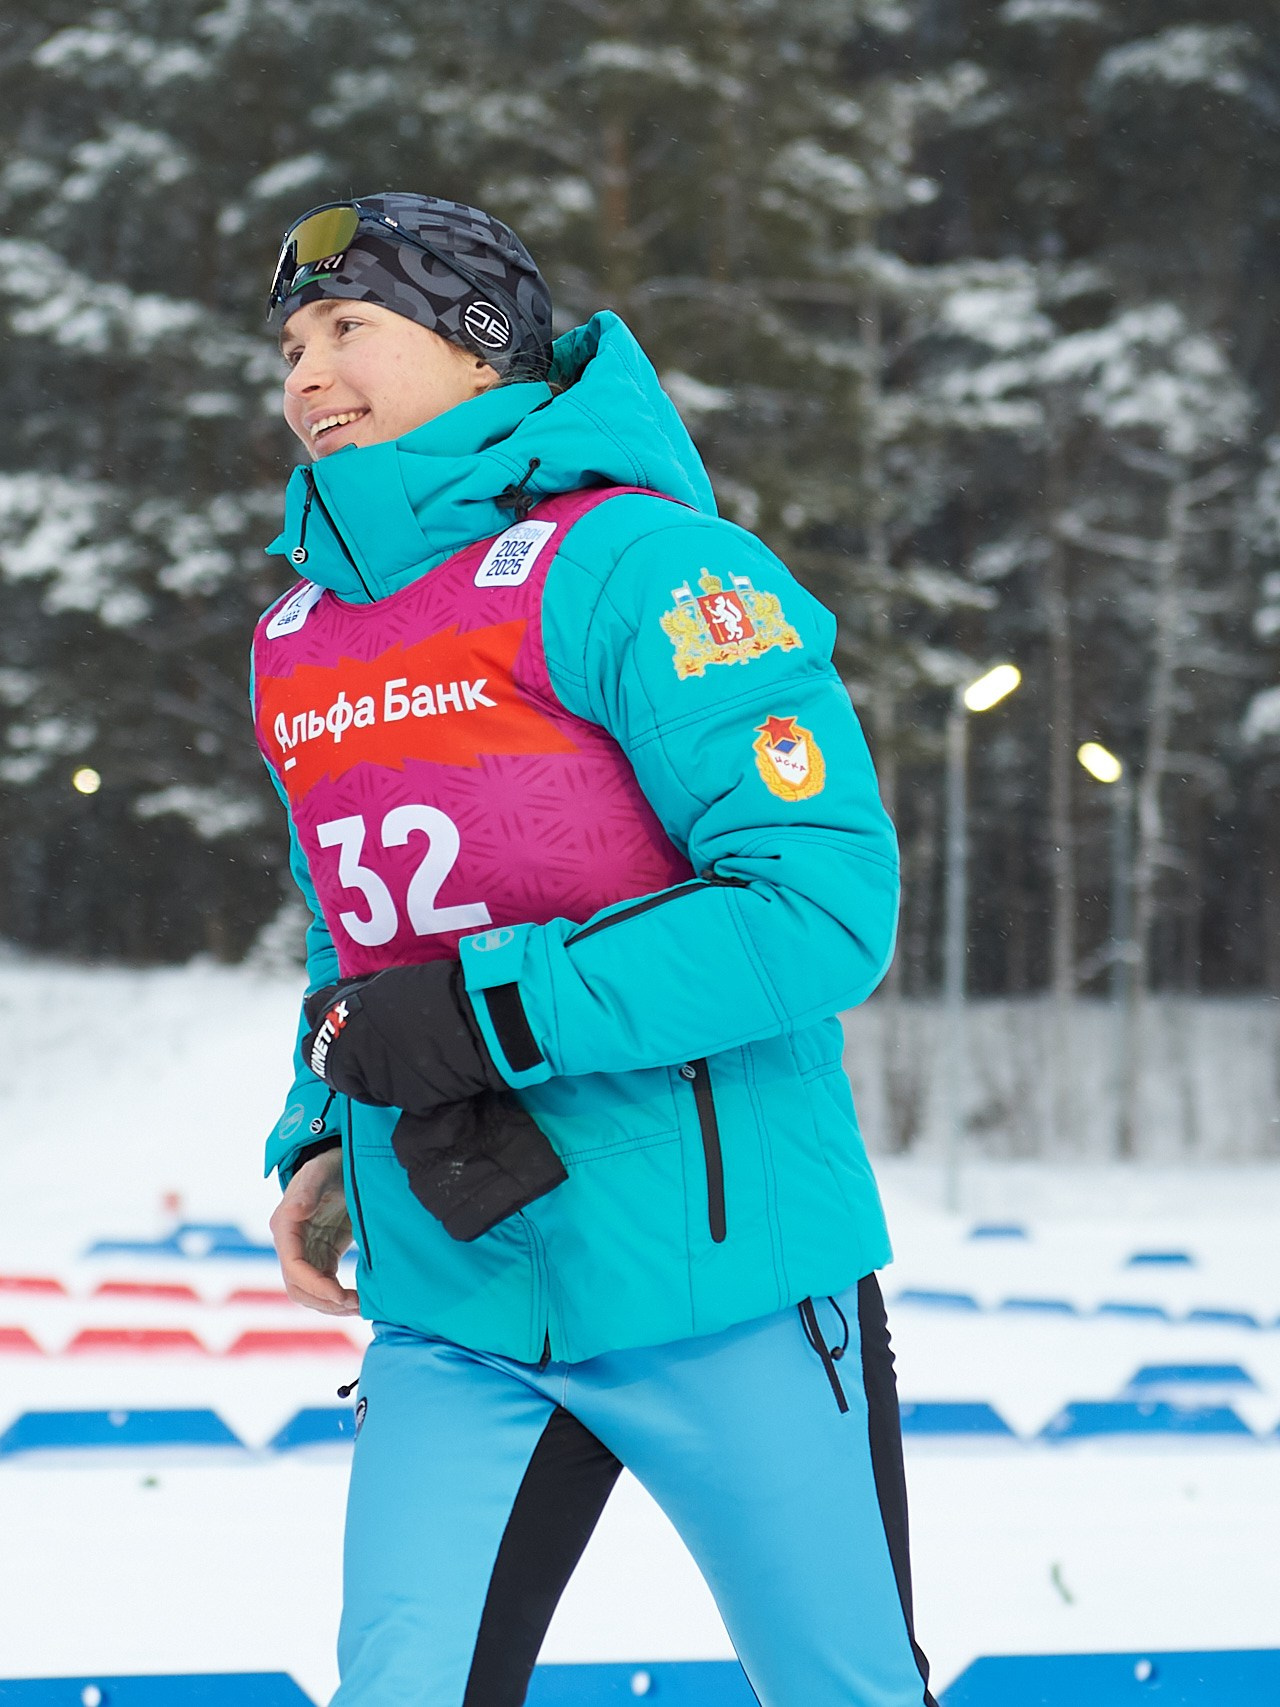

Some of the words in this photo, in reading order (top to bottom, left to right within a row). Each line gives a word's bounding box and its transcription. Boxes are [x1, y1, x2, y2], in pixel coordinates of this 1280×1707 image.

[496, 541, 534, 558] 2024
[486, 558, 525, 577] 2025
[274, 691, 376, 754] Альфа
[383, 677, 497, 722] Банк
[775, 757, 806, 772] ЦСКА
[316, 804, 494, 947] 32
